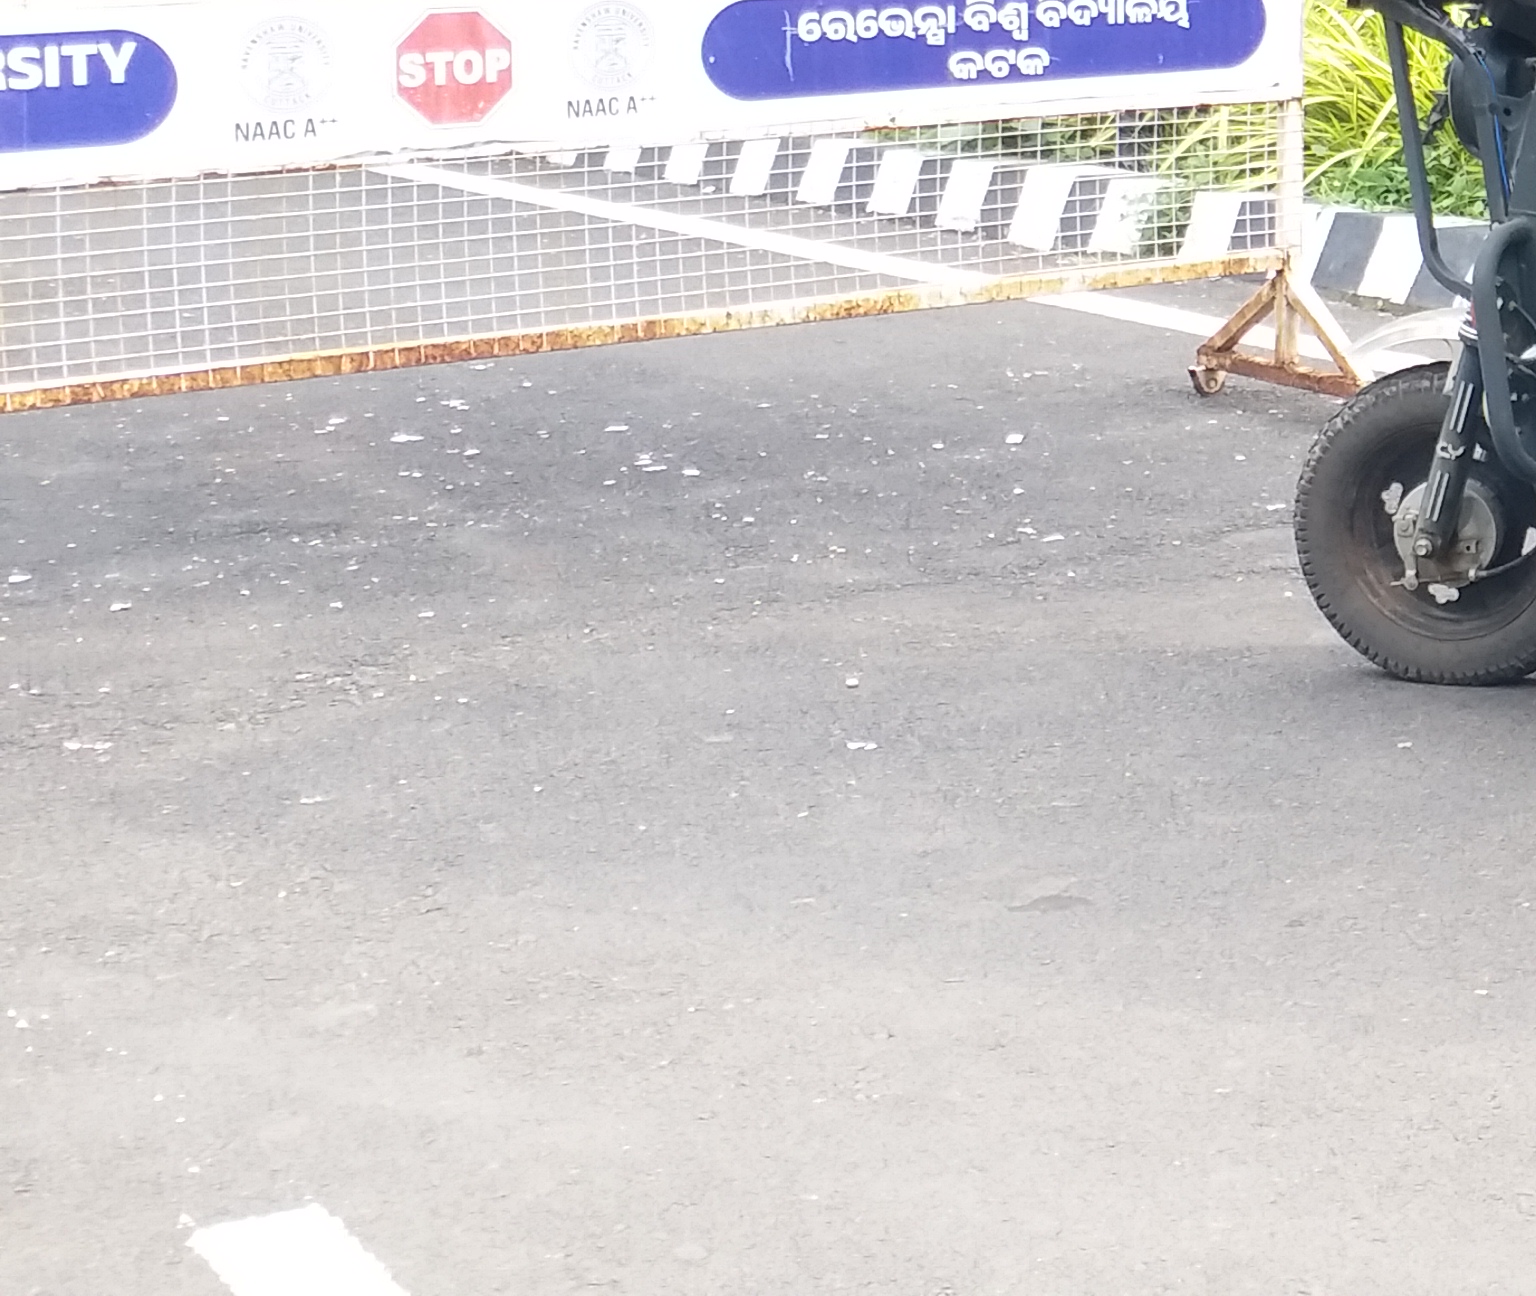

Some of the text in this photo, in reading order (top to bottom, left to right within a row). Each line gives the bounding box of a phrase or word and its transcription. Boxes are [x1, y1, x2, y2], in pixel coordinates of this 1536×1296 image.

[0, 41, 138, 91] SITY
[398, 48, 511, 88] STOP
[948, 48, 1050, 80] କଟକ
[567, 96, 619, 119] NAAC
[235, 119, 295, 142] NAAC
